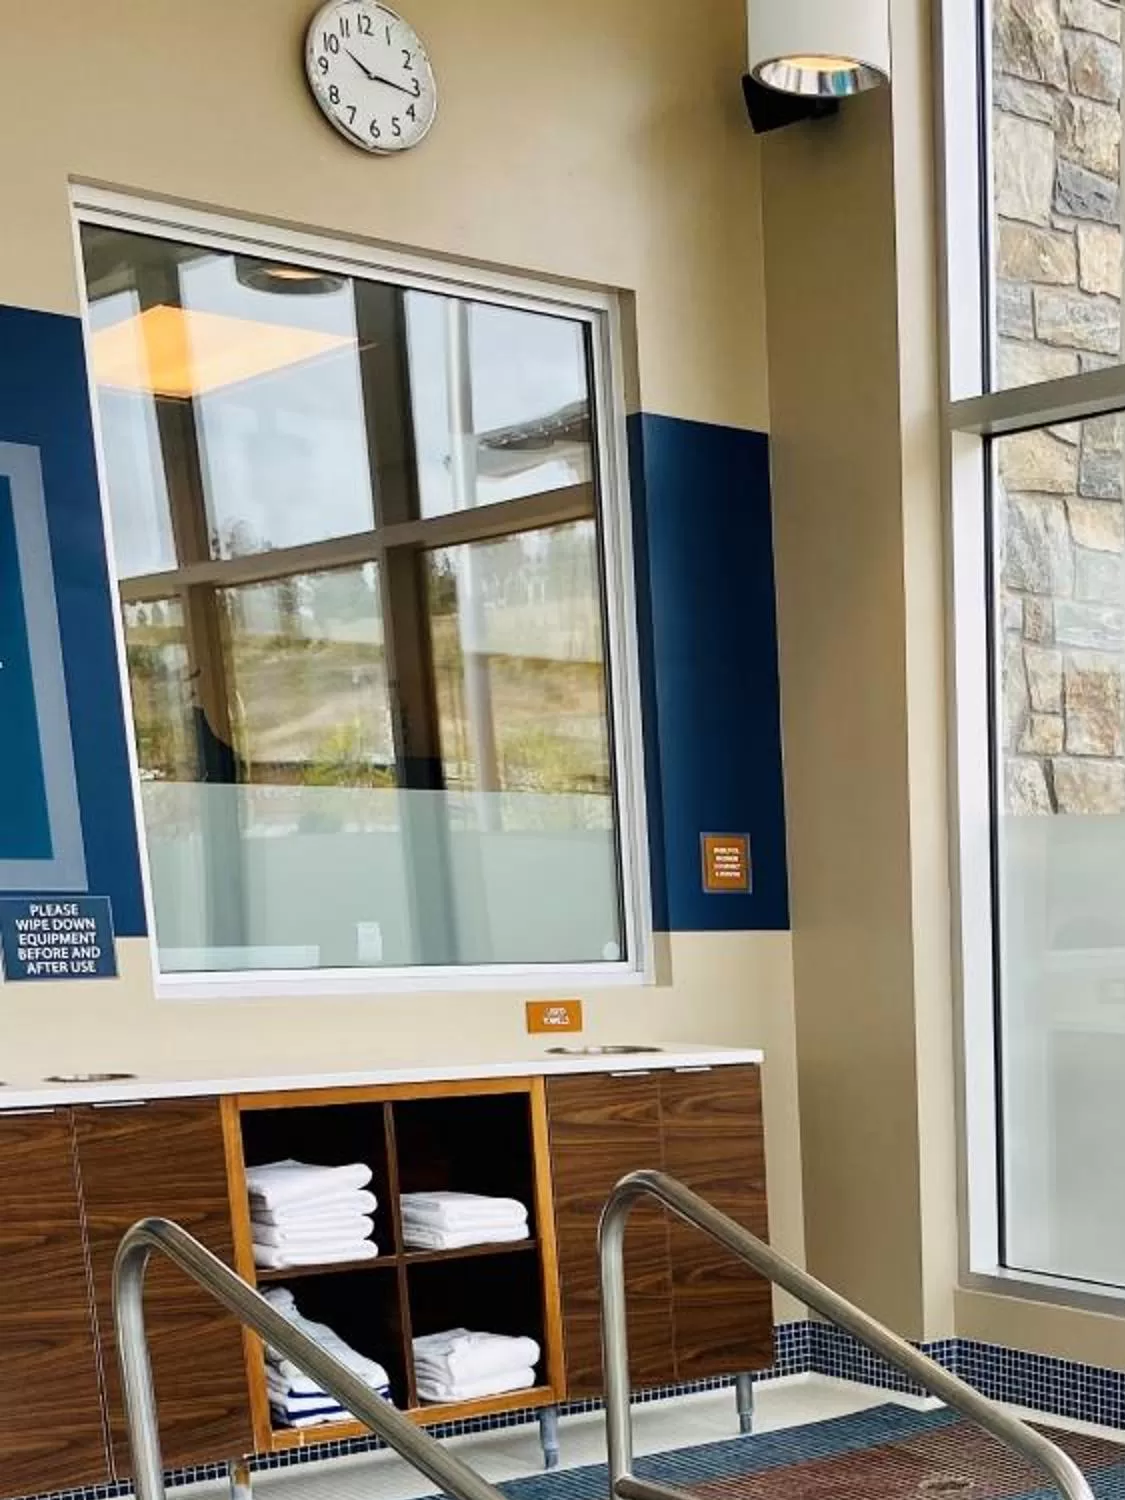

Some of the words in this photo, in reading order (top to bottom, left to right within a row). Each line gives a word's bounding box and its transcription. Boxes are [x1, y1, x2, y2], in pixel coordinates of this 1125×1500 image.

[339, 17, 350, 38] 11
[357, 13, 374, 36] 12
[323, 32, 340, 54] 10
[385, 25, 391, 46] 1
[318, 55, 329, 75] 9
[401, 49, 413, 70] 2
[328, 84, 340, 105] 8
[411, 78, 420, 97] 3
[346, 105, 357, 125] 7
[406, 103, 416, 122] 4
[369, 119, 381, 138] 6
[391, 117, 401, 137] 5
[29, 903, 79, 916] PLEASE
[15, 919, 50, 931] WIPE
[53, 918, 96, 931] DOWN
[19, 932, 96, 946] EQUIPMENT
[17, 947, 69, 960] BEFORE
[71, 946, 101, 959] AND
[27, 961, 68, 975] AFTER
[70, 961, 97, 973] USE
